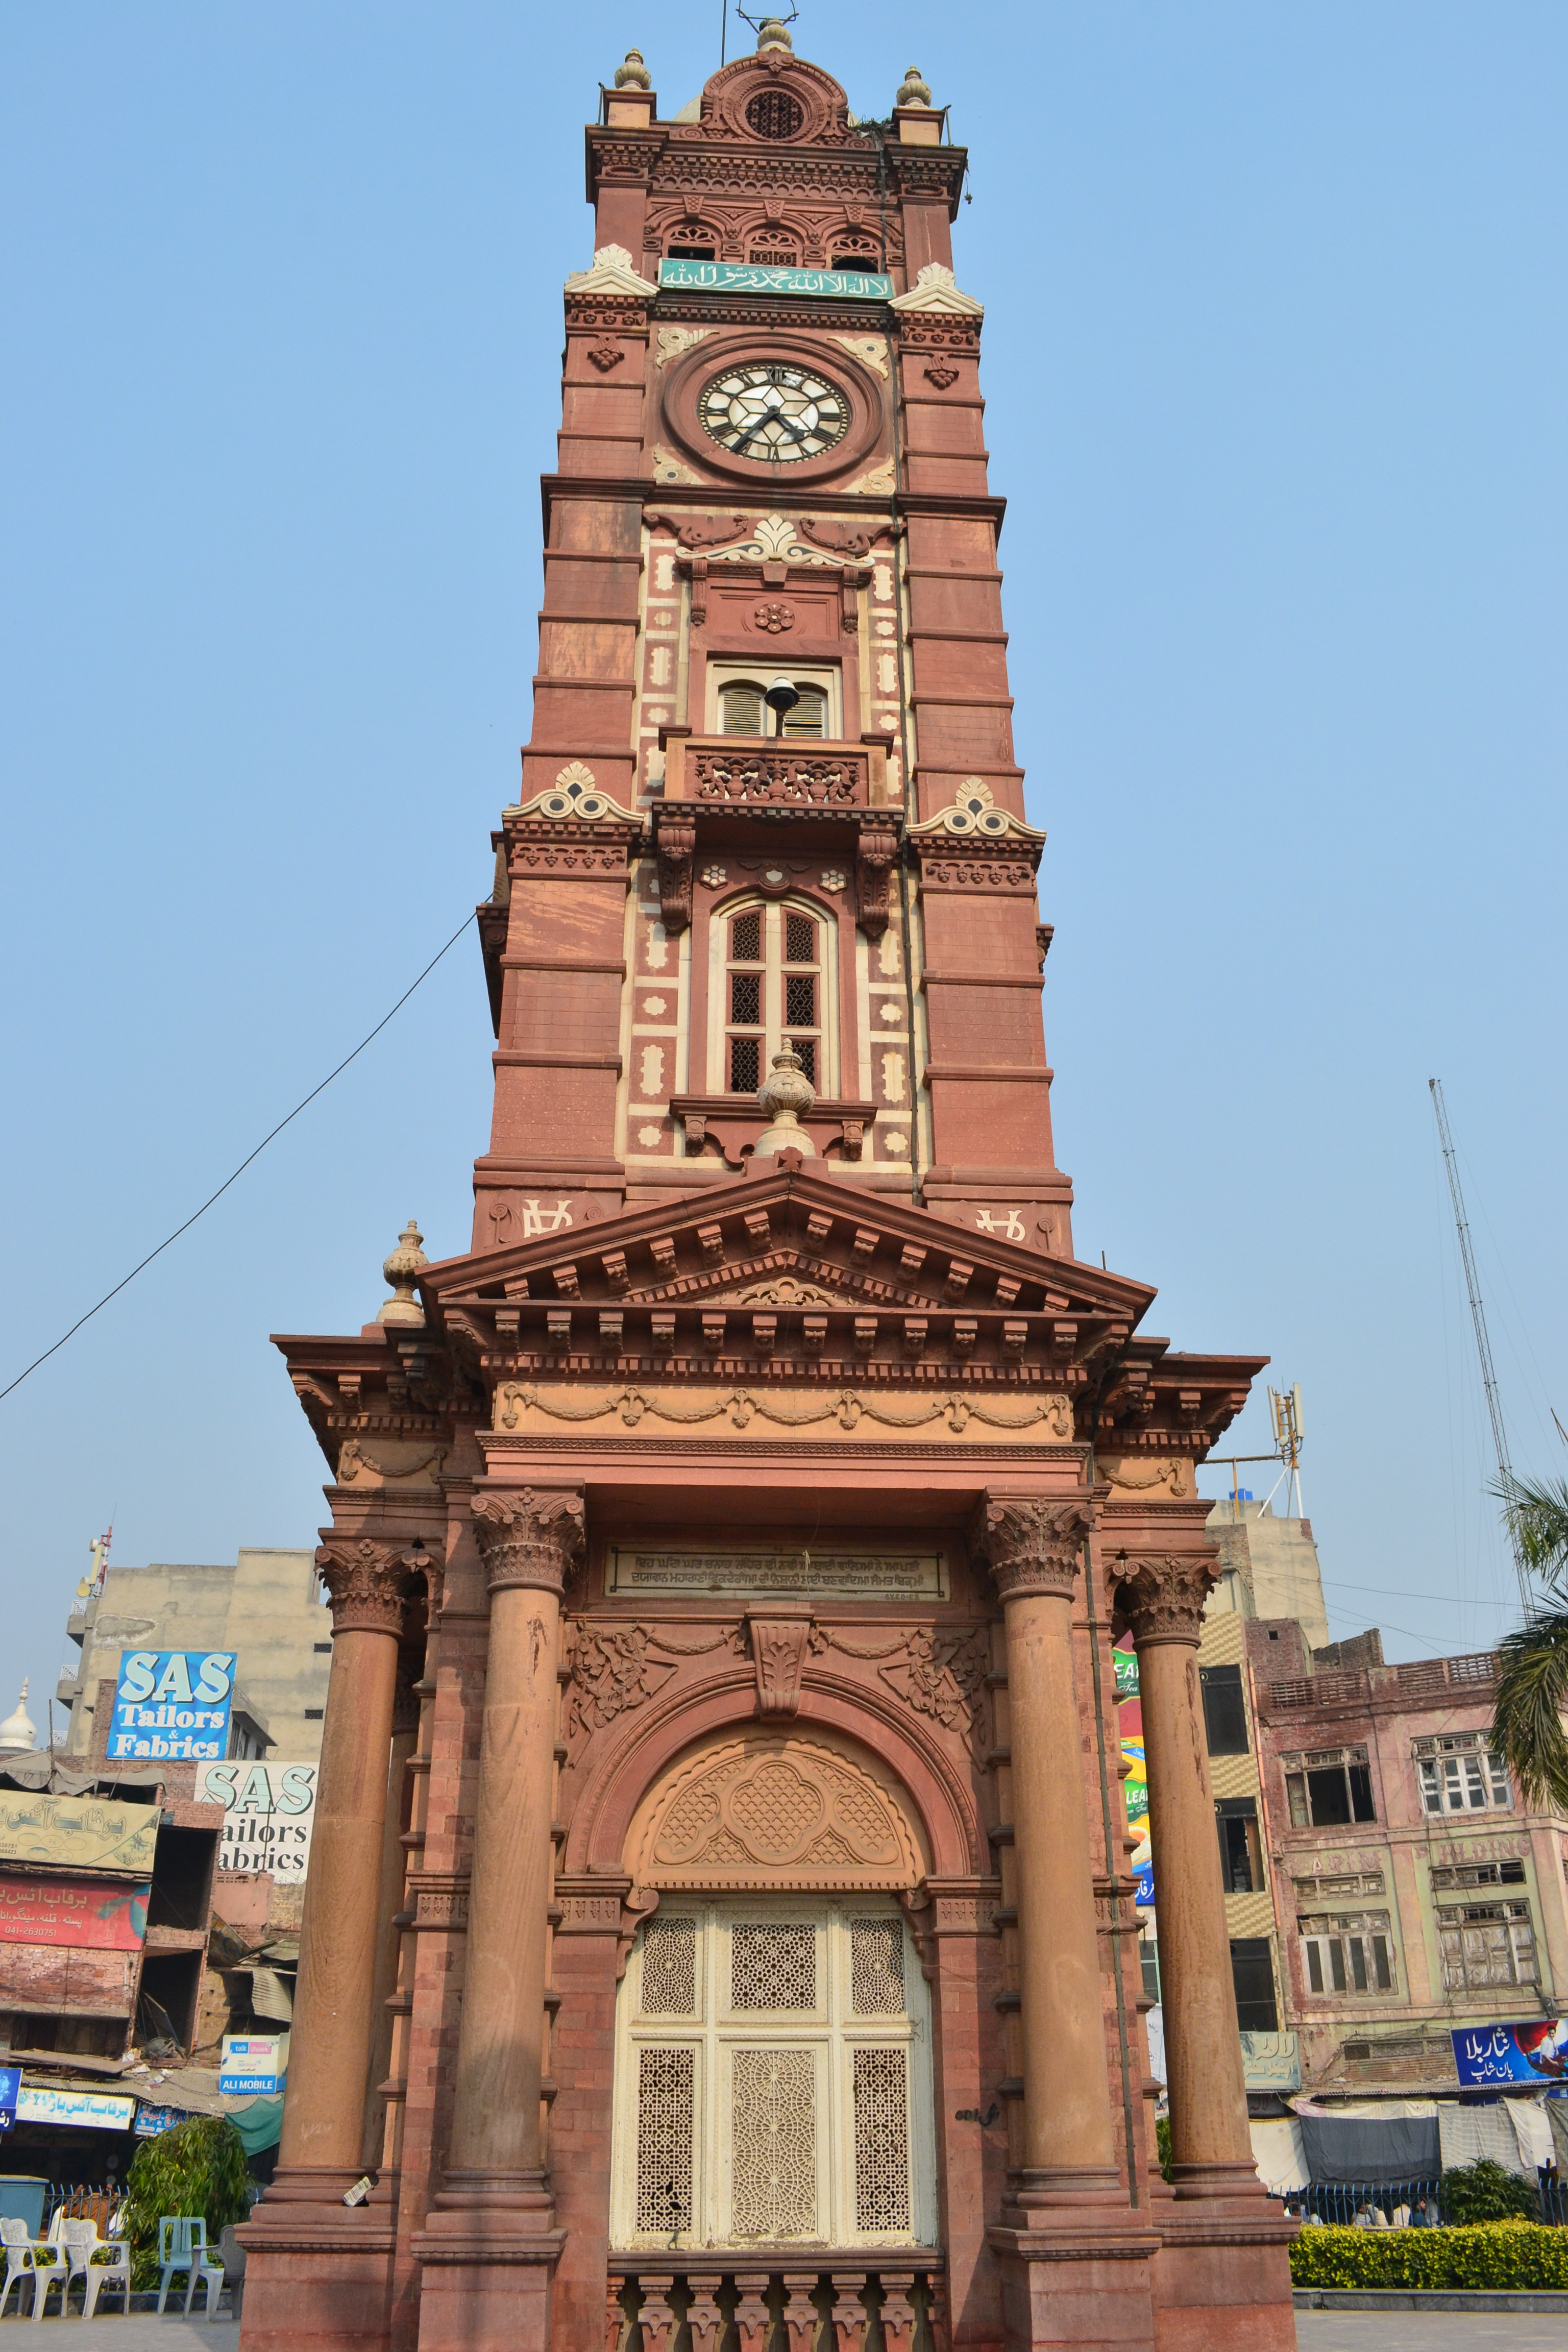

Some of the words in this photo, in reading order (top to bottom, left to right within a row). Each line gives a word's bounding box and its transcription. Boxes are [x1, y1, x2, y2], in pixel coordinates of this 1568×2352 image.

[118, 1653, 234, 1704] SAS
[118, 1704, 225, 1728] Tailors
[113, 1734, 219, 1758] Fabrics
[168, 1729, 179, 1739] &
[201, 1765, 316, 1815] SAS
[222, 1818, 307, 1844] ailors
[218, 1847, 304, 1870] abrics
[5, 1926, 57, 1937] 041-2630751
[223, 2080, 237, 2089] ALI
[239, 2080, 273, 2089] MOBILE
